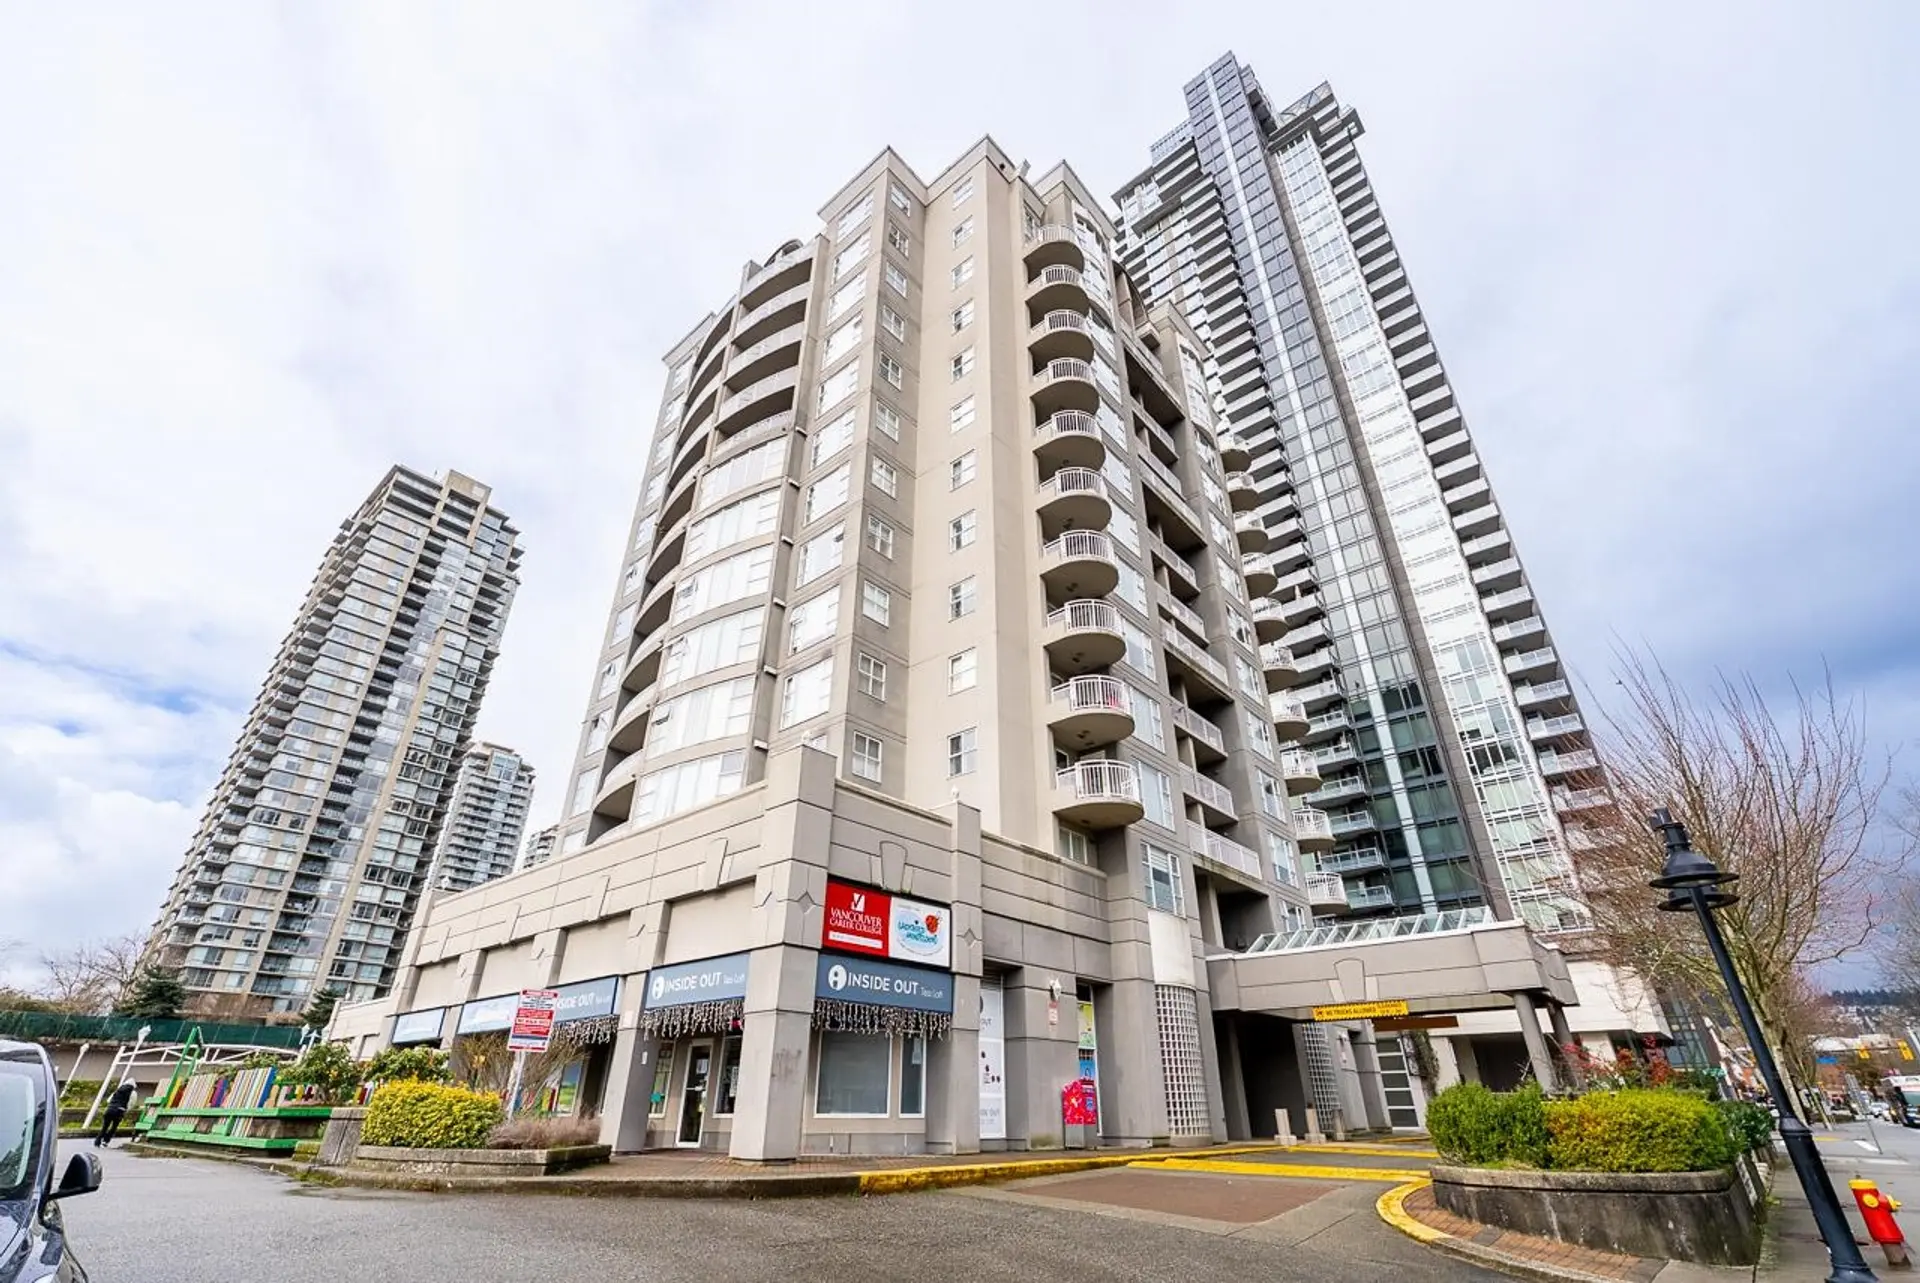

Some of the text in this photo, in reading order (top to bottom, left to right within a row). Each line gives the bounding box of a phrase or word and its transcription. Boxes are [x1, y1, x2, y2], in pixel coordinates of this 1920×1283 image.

[829, 918, 855, 930] CAREER
[855, 922, 882, 936] COLLEGE
[830, 907, 882, 927] VANCOUVER
[664, 975, 698, 994] INSIDE
[700, 972, 722, 988] OUT
[848, 972, 891, 992] INSIDE
[894, 979, 919, 995] OUT
